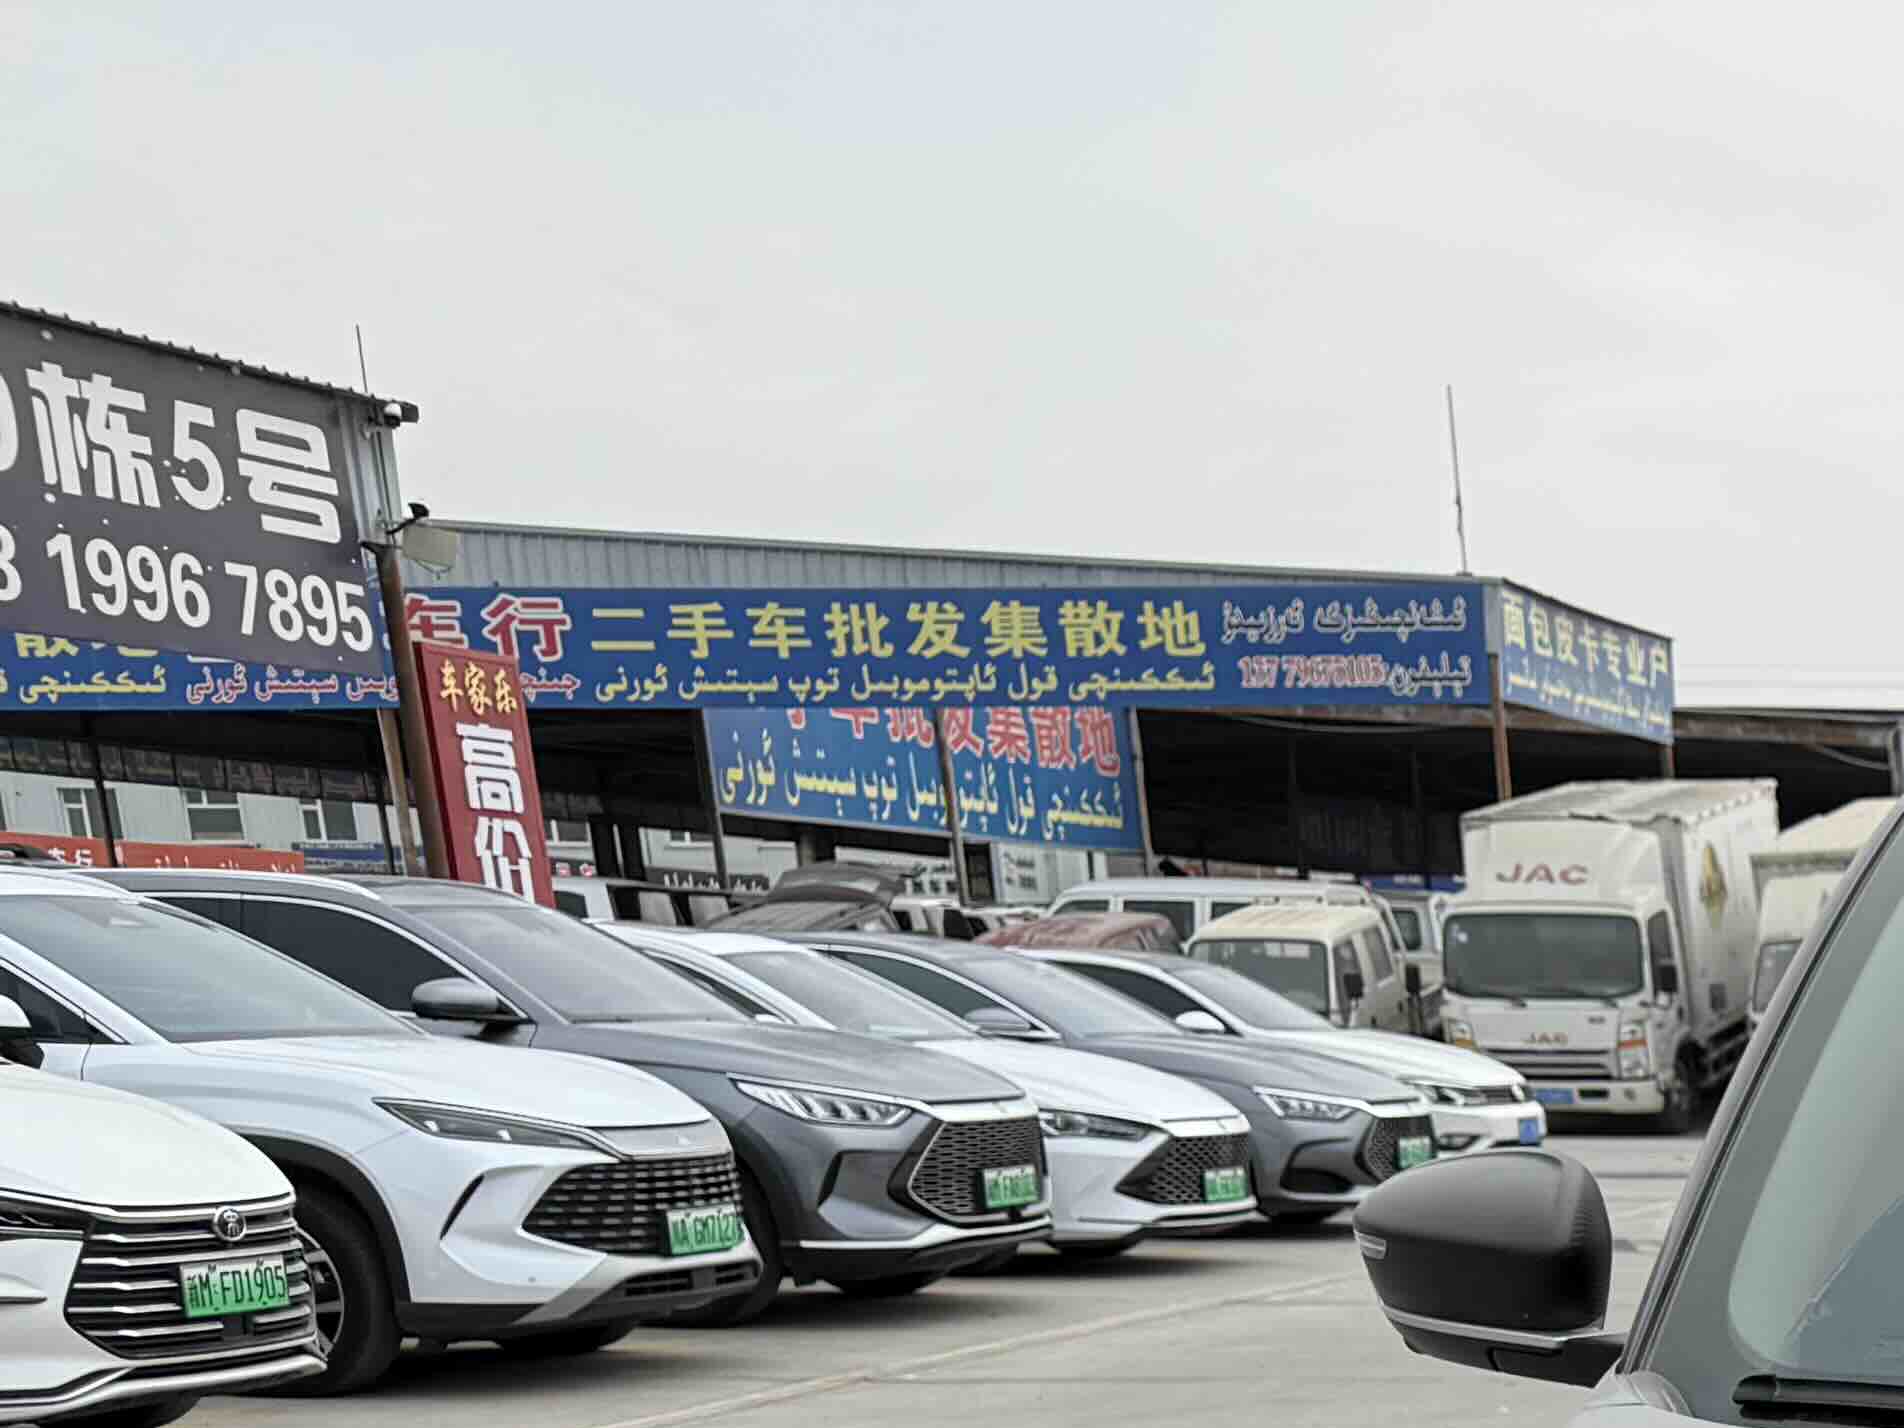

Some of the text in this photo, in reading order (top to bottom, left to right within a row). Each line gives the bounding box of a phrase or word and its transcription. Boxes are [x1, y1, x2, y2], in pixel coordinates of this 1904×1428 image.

[45, 533, 211, 628] 1996
[224, 561, 374, 653] 7895
[1496, 863, 1589, 886] JAC
